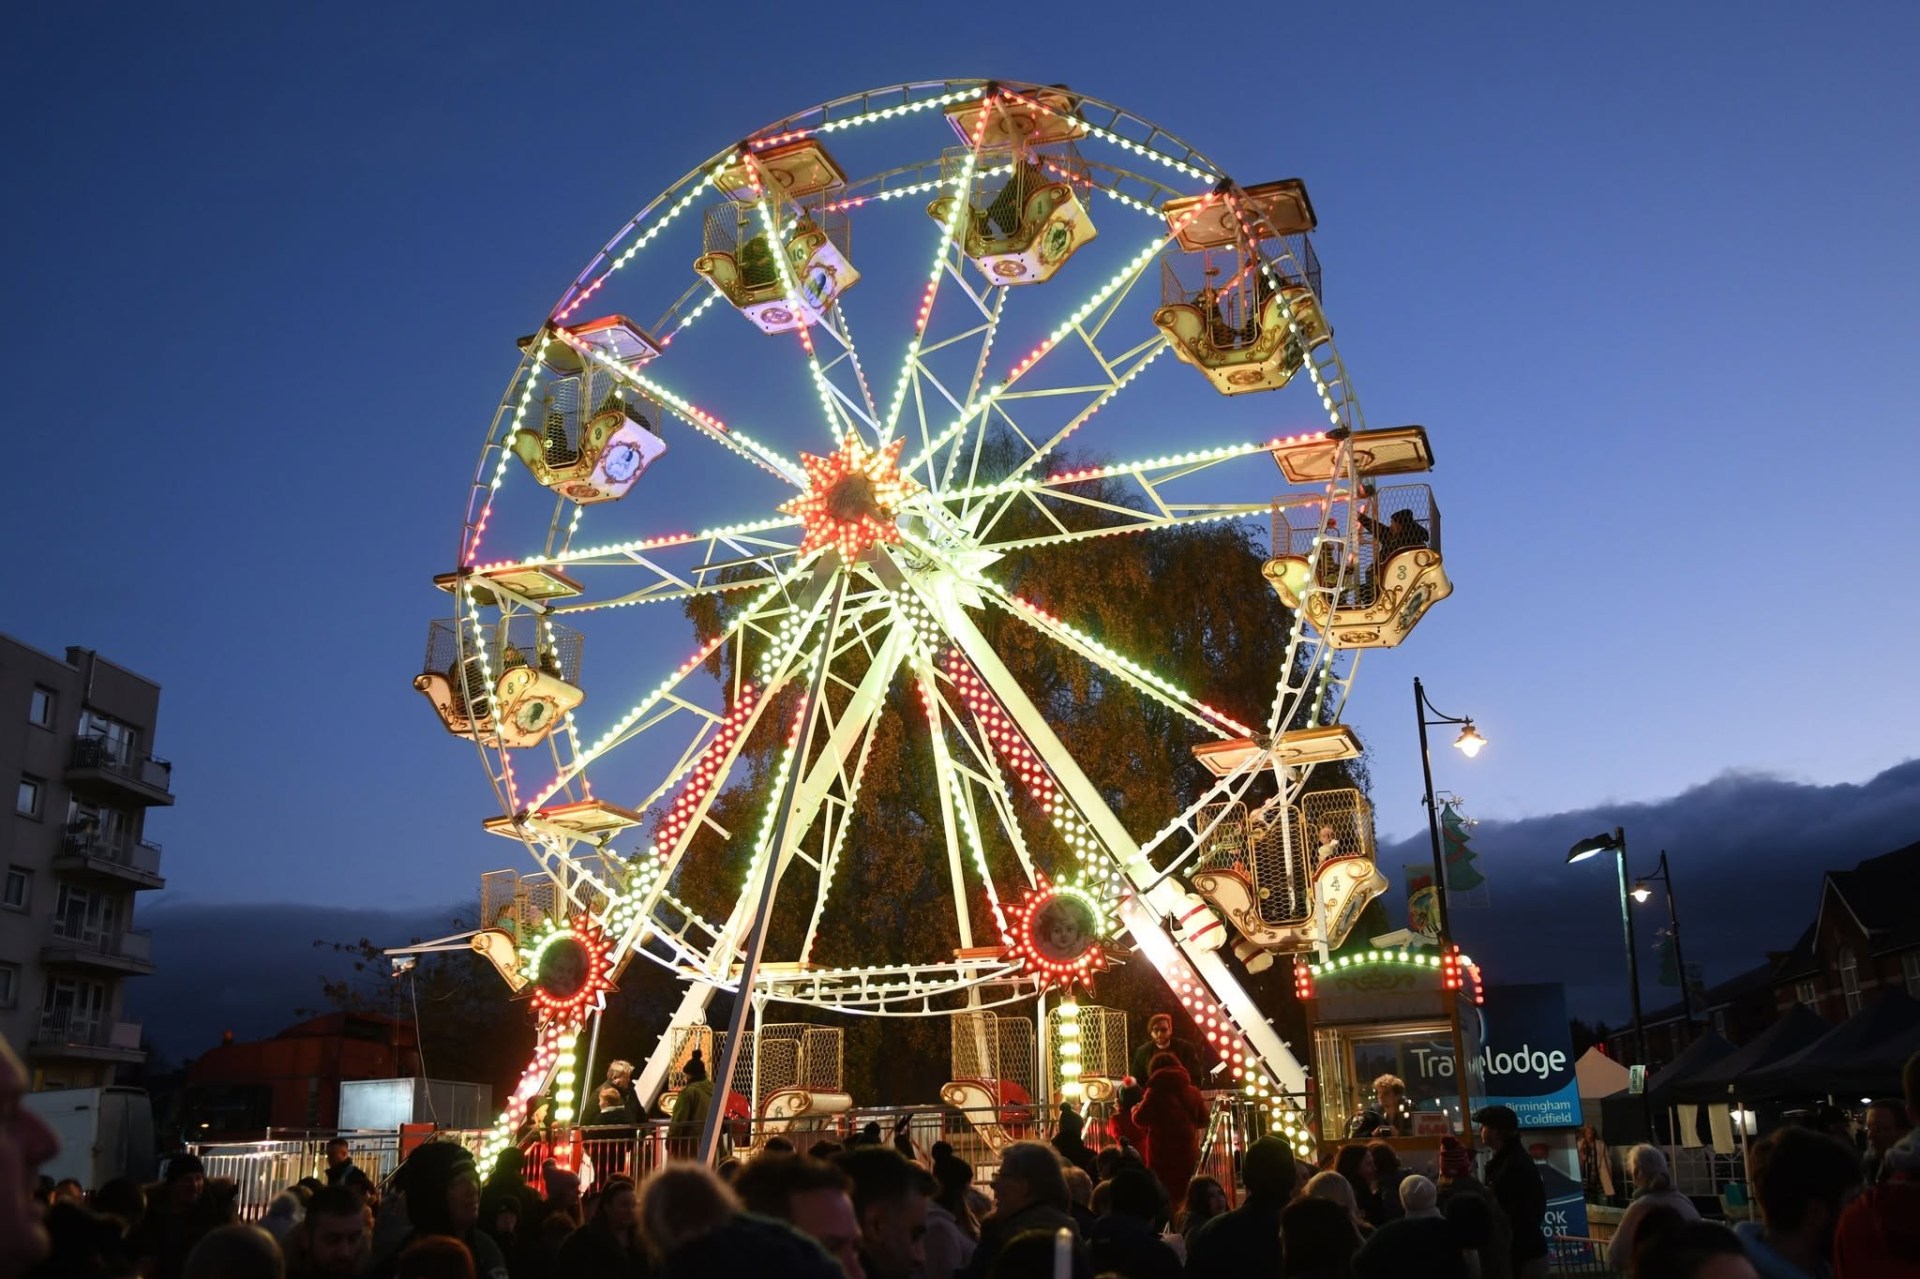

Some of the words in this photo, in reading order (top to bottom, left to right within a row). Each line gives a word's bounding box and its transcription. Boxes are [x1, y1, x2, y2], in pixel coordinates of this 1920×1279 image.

[1396, 564, 1407, 581] 3
[507, 681, 515, 695] 8
[1330, 875, 1341, 892] 4
[1410, 1043, 1567, 1080] Tralodge
[1524, 1112, 1573, 1126] Coldfield
[1544, 1209, 1568, 1225] OK
[1542, 1225, 1569, 1238] ORT
